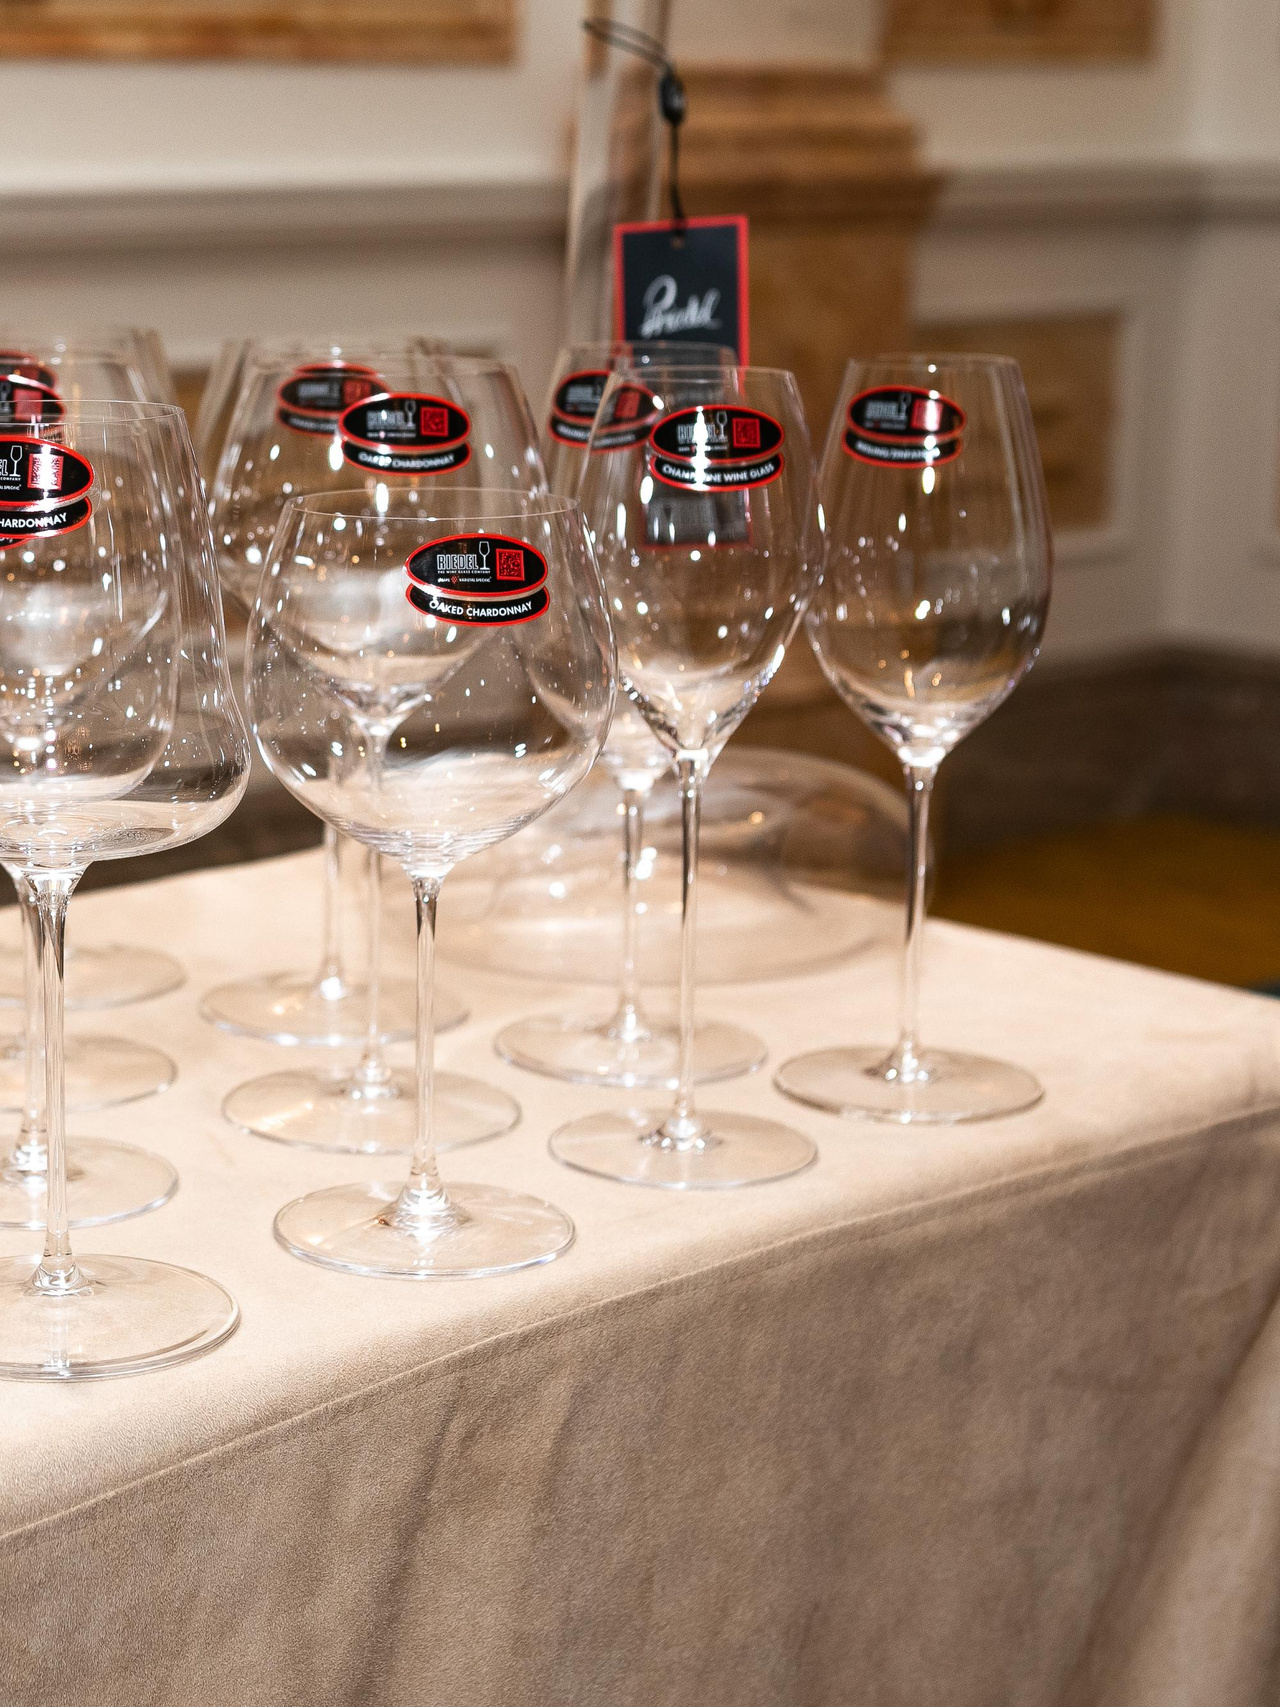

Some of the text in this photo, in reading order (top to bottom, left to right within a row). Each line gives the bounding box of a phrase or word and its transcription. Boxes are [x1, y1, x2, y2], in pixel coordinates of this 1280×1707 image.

[723, 470, 749, 483] WINE
[749, 462, 775, 479] GLASS
[436, 554, 479, 570] RIEDEL
[429, 600, 532, 617] OAKED CHARDONNAY
